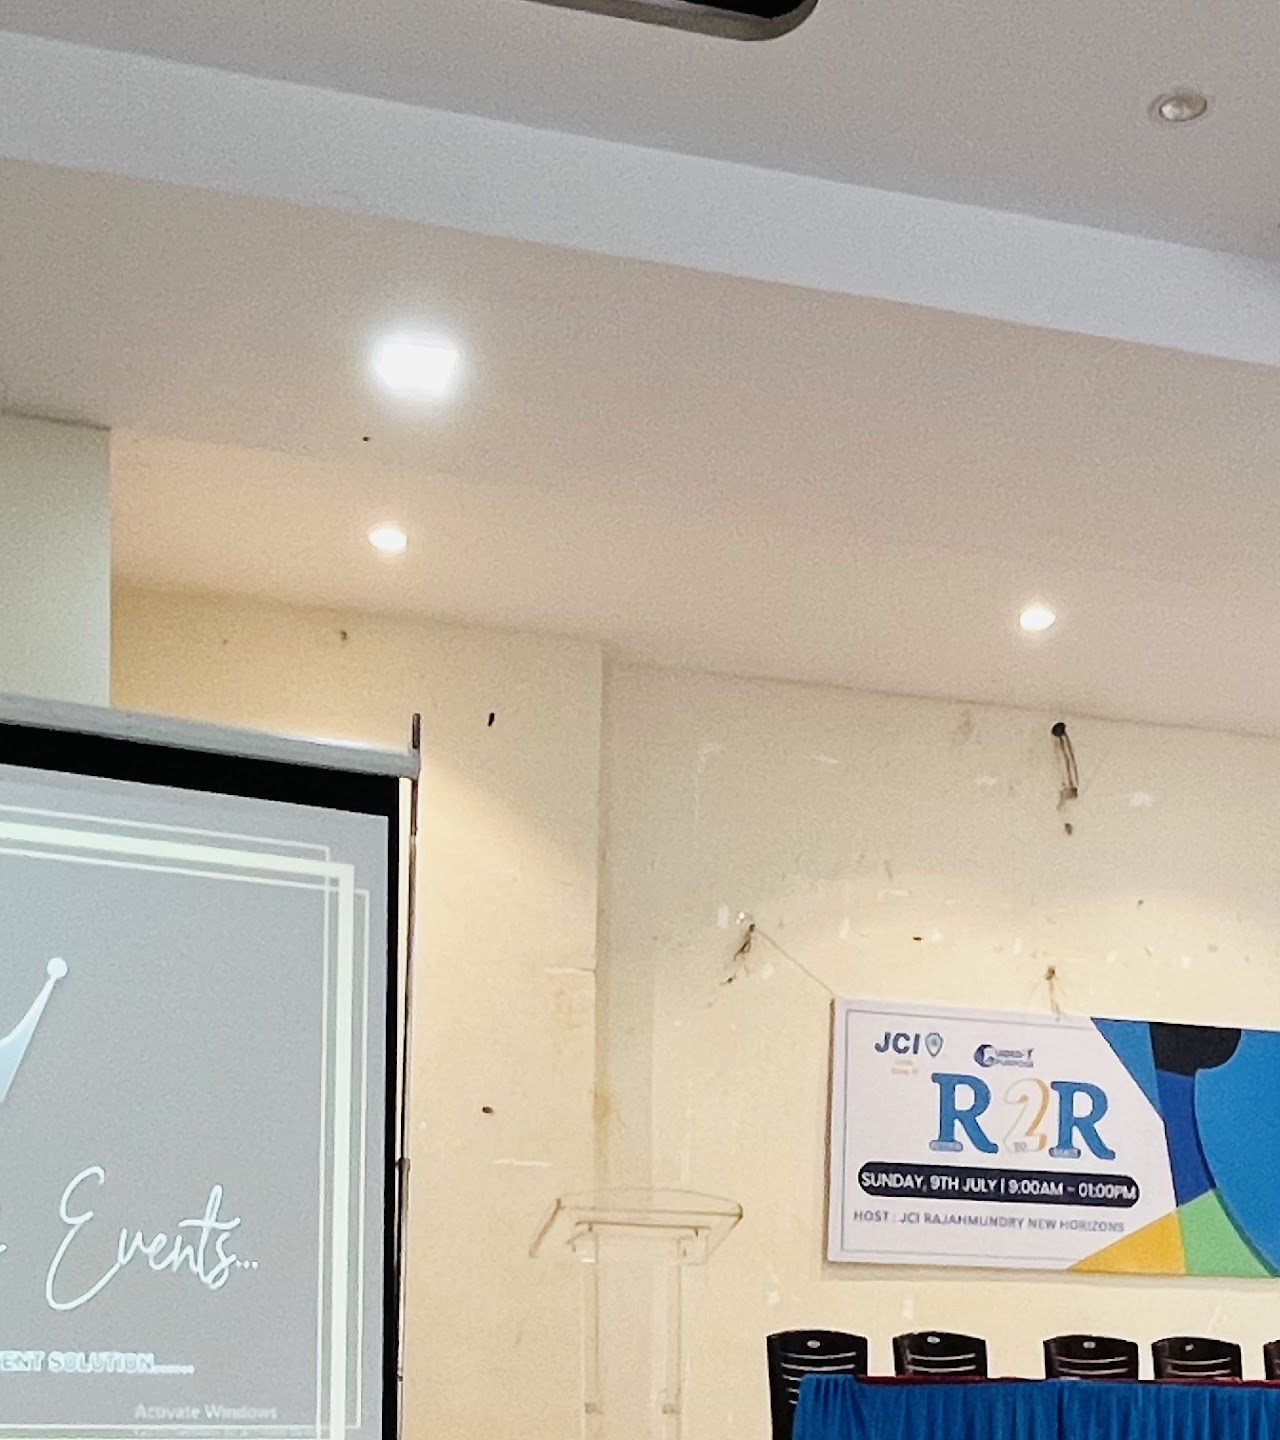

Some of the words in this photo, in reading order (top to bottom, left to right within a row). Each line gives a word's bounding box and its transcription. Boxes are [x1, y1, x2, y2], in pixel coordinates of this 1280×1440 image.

[874, 1031, 920, 1055] JCI
[861, 1171, 927, 1193] SUNDAY,
[929, 1175, 959, 1191] 9TH
[961, 1177, 998, 1193] JULY
[1008, 1179, 1064, 1196] 9:00AM
[853, 1210, 889, 1223] HOST
[900, 1212, 920, 1224] JCI
[1027, 1217, 1057, 1230] NEW
[1060, 1219, 1125, 1233] HORIZONS
